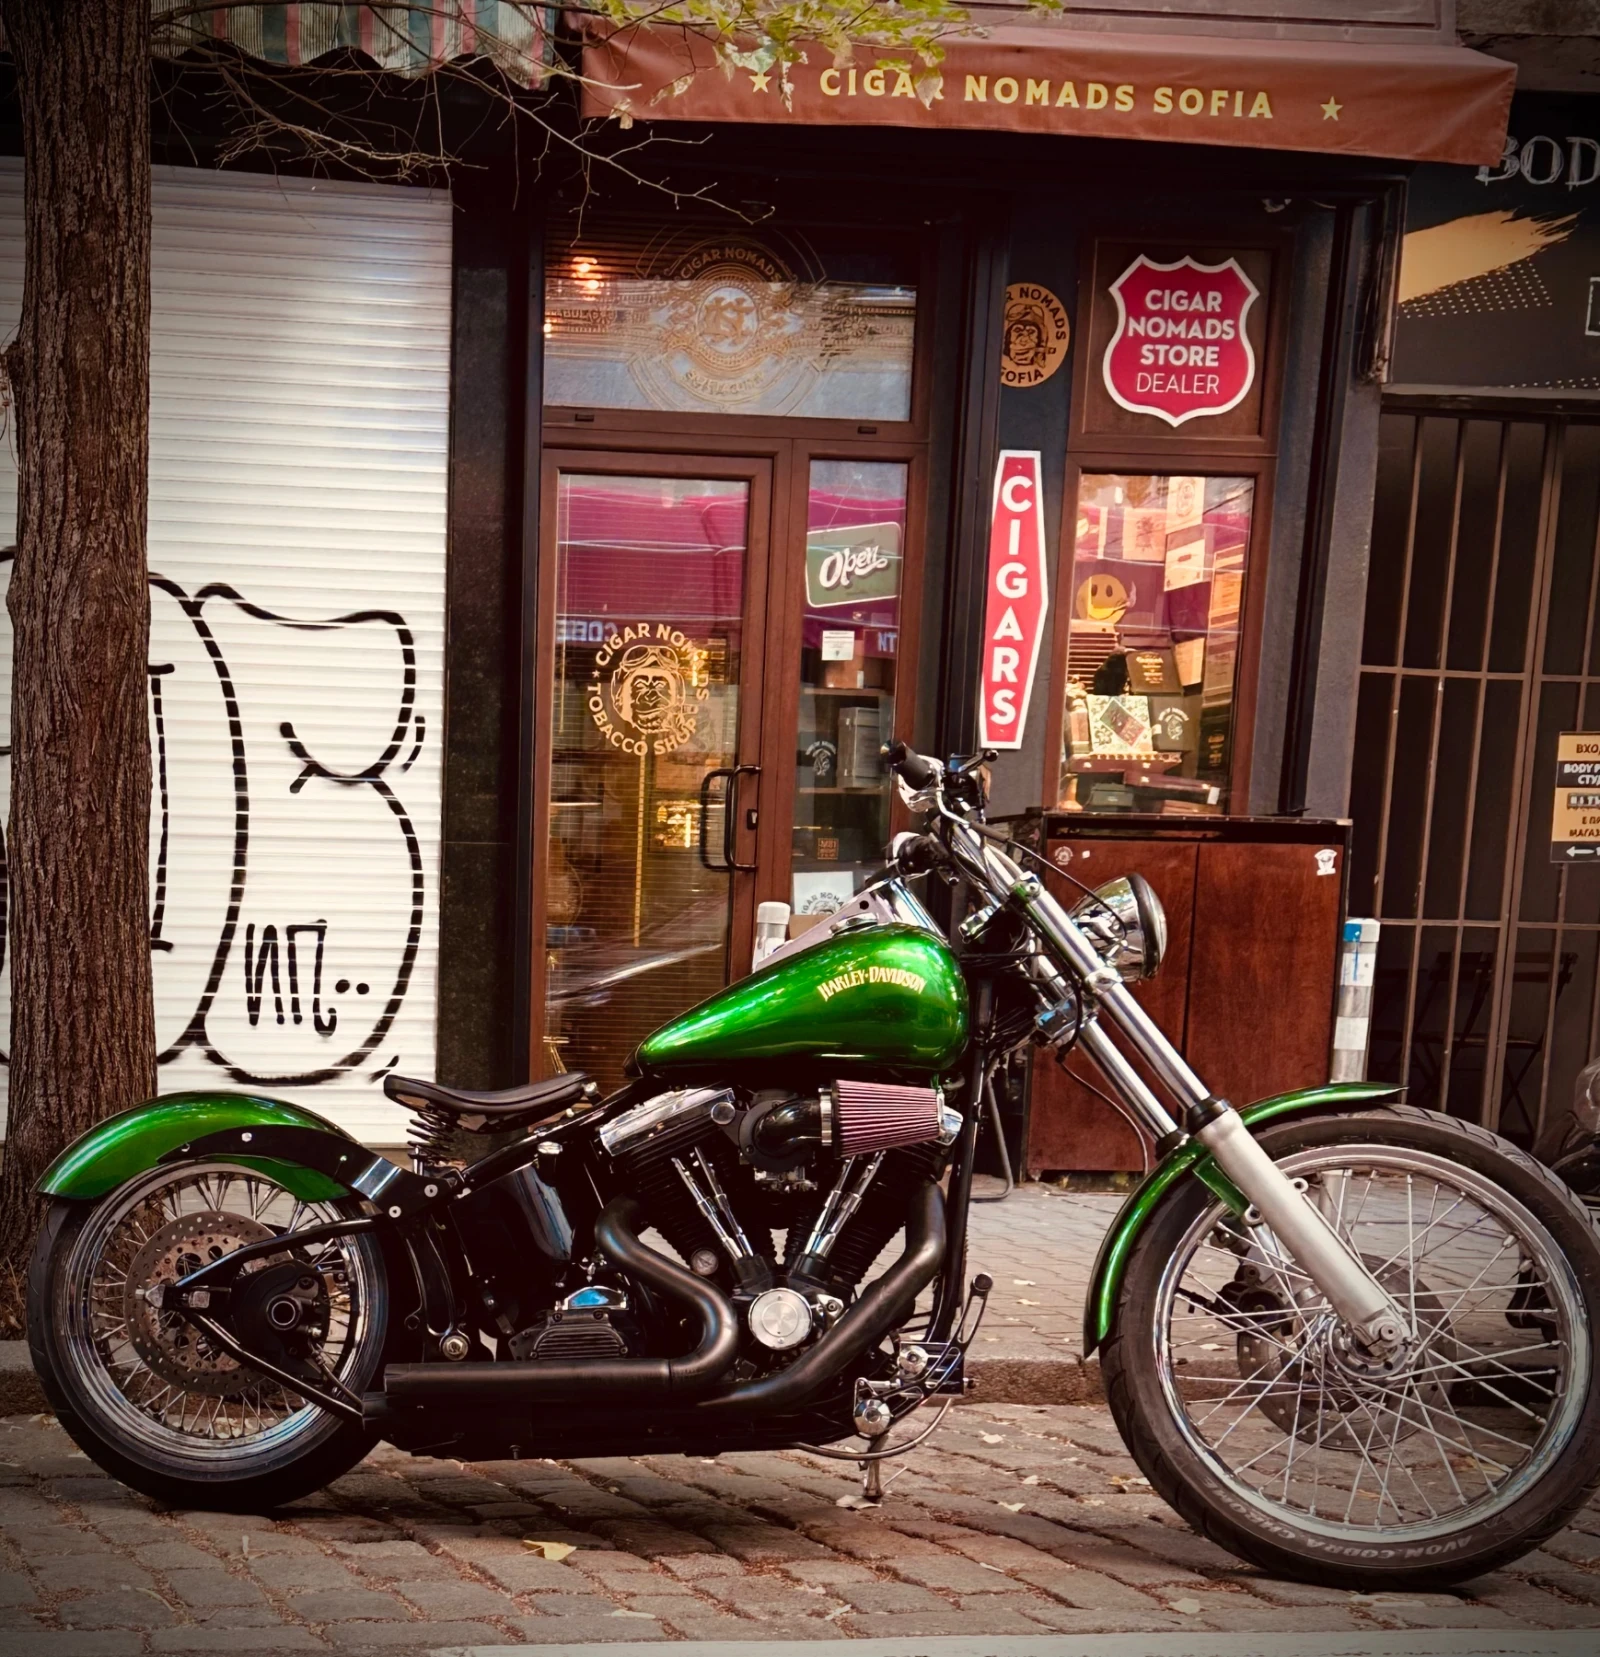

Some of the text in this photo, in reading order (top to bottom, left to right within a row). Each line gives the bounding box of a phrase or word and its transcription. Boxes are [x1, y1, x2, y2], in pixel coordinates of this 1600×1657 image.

[964, 75, 1134, 112] NOMADS
[1153, 87, 1273, 119] SOFIA
[680, 247, 782, 283] CIGAR NOMADS
[1145, 289, 1222, 312] CIGAR
[1019, 287, 1067, 341] NOMADS
[1128, 316, 1235, 340] NOMADS
[1140, 344, 1219, 367] STORE
[1136, 372, 1219, 394] DEALER
[819, 545, 888, 588] Open
[990, 475, 1034, 726] CIGARS
[595, 623, 651, 667] CIGAR
[588, 683, 697, 756] TOBACCO SHOP
[1576, 743, 1600, 756] ВХО
[1564, 763, 1593, 774] BODY
[801, 891, 844, 914] IGAR NOMA
[1306, 1537, 1395, 1560] COBRA
[1404, 1534, 1472, 1558] AVON
